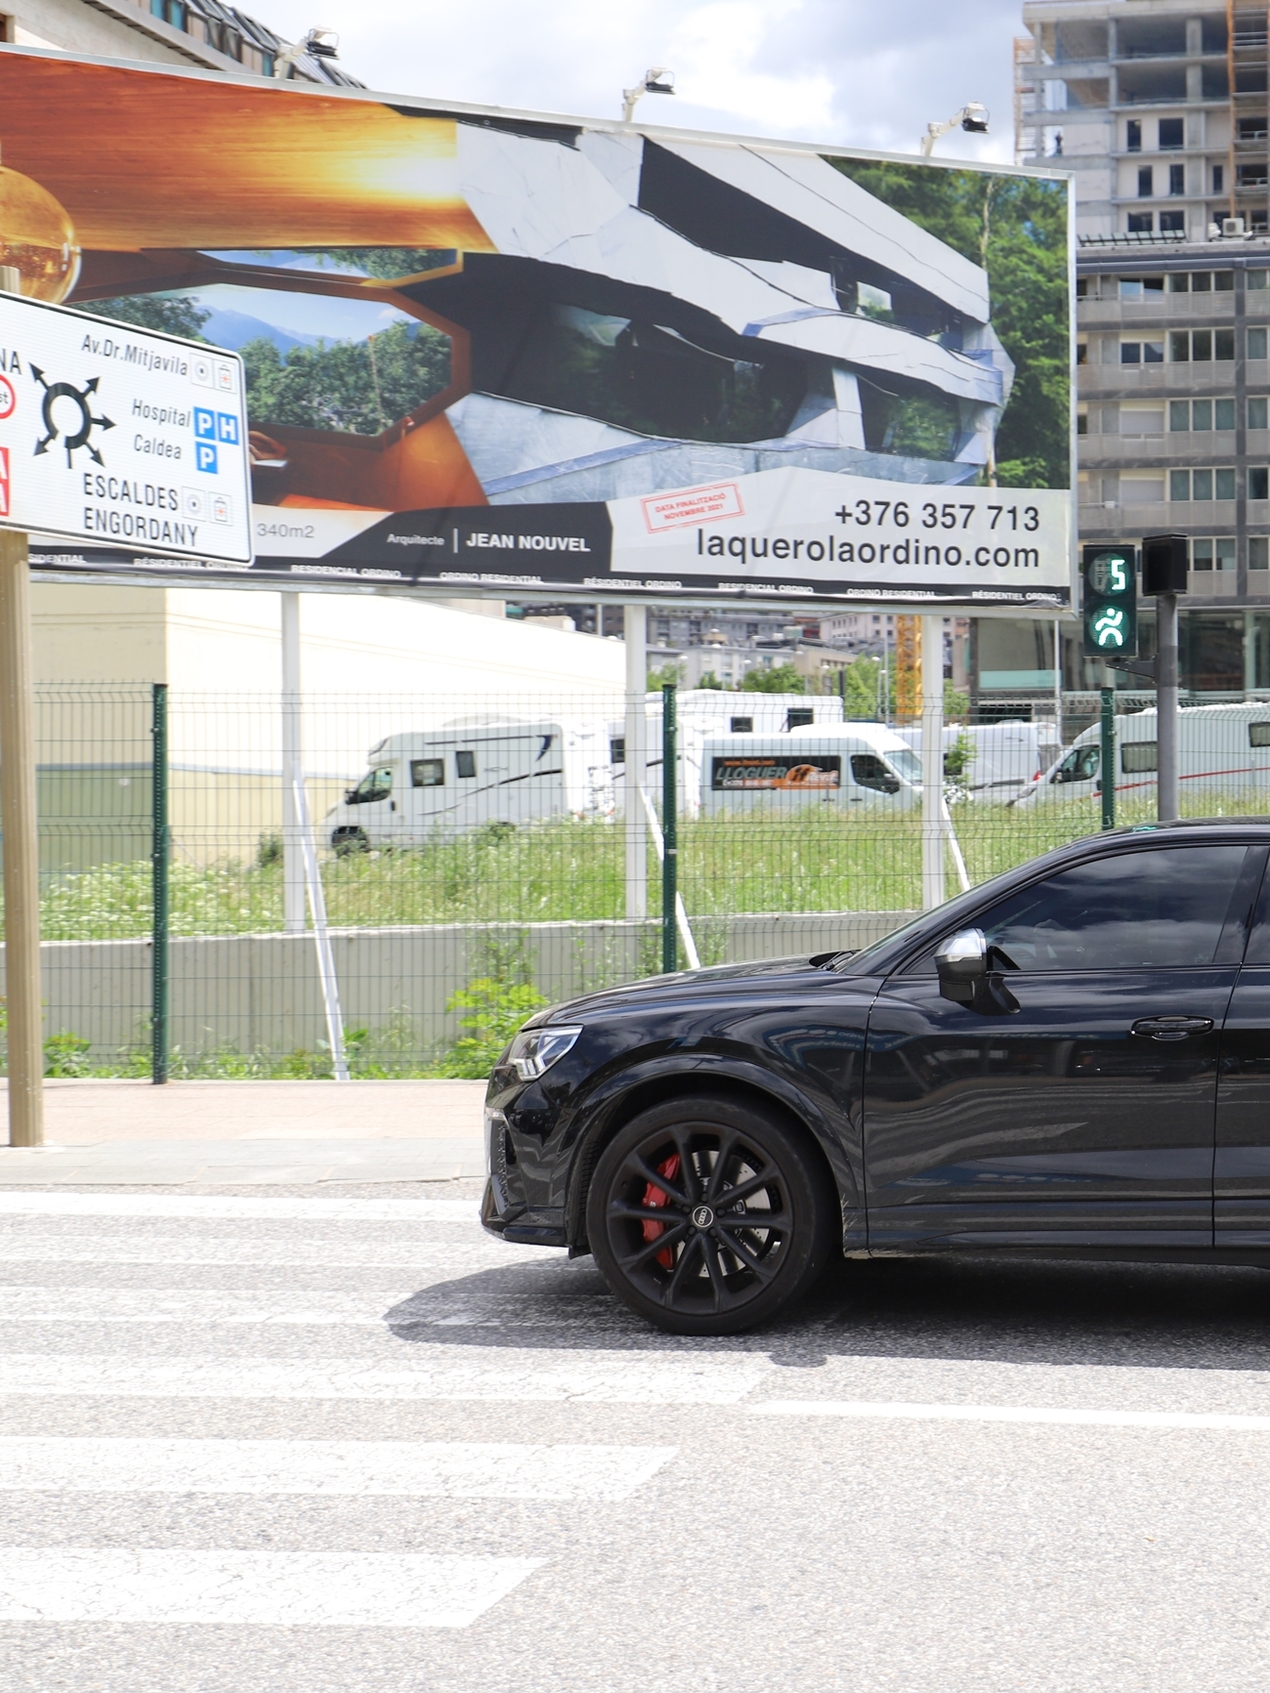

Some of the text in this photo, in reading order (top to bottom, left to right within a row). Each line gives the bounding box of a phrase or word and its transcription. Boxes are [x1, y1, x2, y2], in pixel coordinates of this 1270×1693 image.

[132, 398, 191, 427] Hospital
[134, 434, 182, 460] Caldea
[83, 472, 179, 511] ESCALDES
[655, 504, 676, 513] DATA
[664, 503, 724, 521] NOVEMBRE 2021
[835, 499, 1040, 532] +376 357 713
[84, 506, 198, 547] ENGORDANY
[257, 523, 315, 539] 340m2
[386, 533, 445, 546] Arquitecte
[466, 533, 591, 552] JEAN NOUVEL
[698, 527, 1040, 568] laquerolaordino.com
[291, 565, 402, 579] RESIDENCIAL ORDINO
[1111, 559, 1126, 591] 5
[646, 580, 683, 589] ORDINO
[779, 584, 814, 594] ORDINO
[716, 766, 787, 779] LLOGUER
